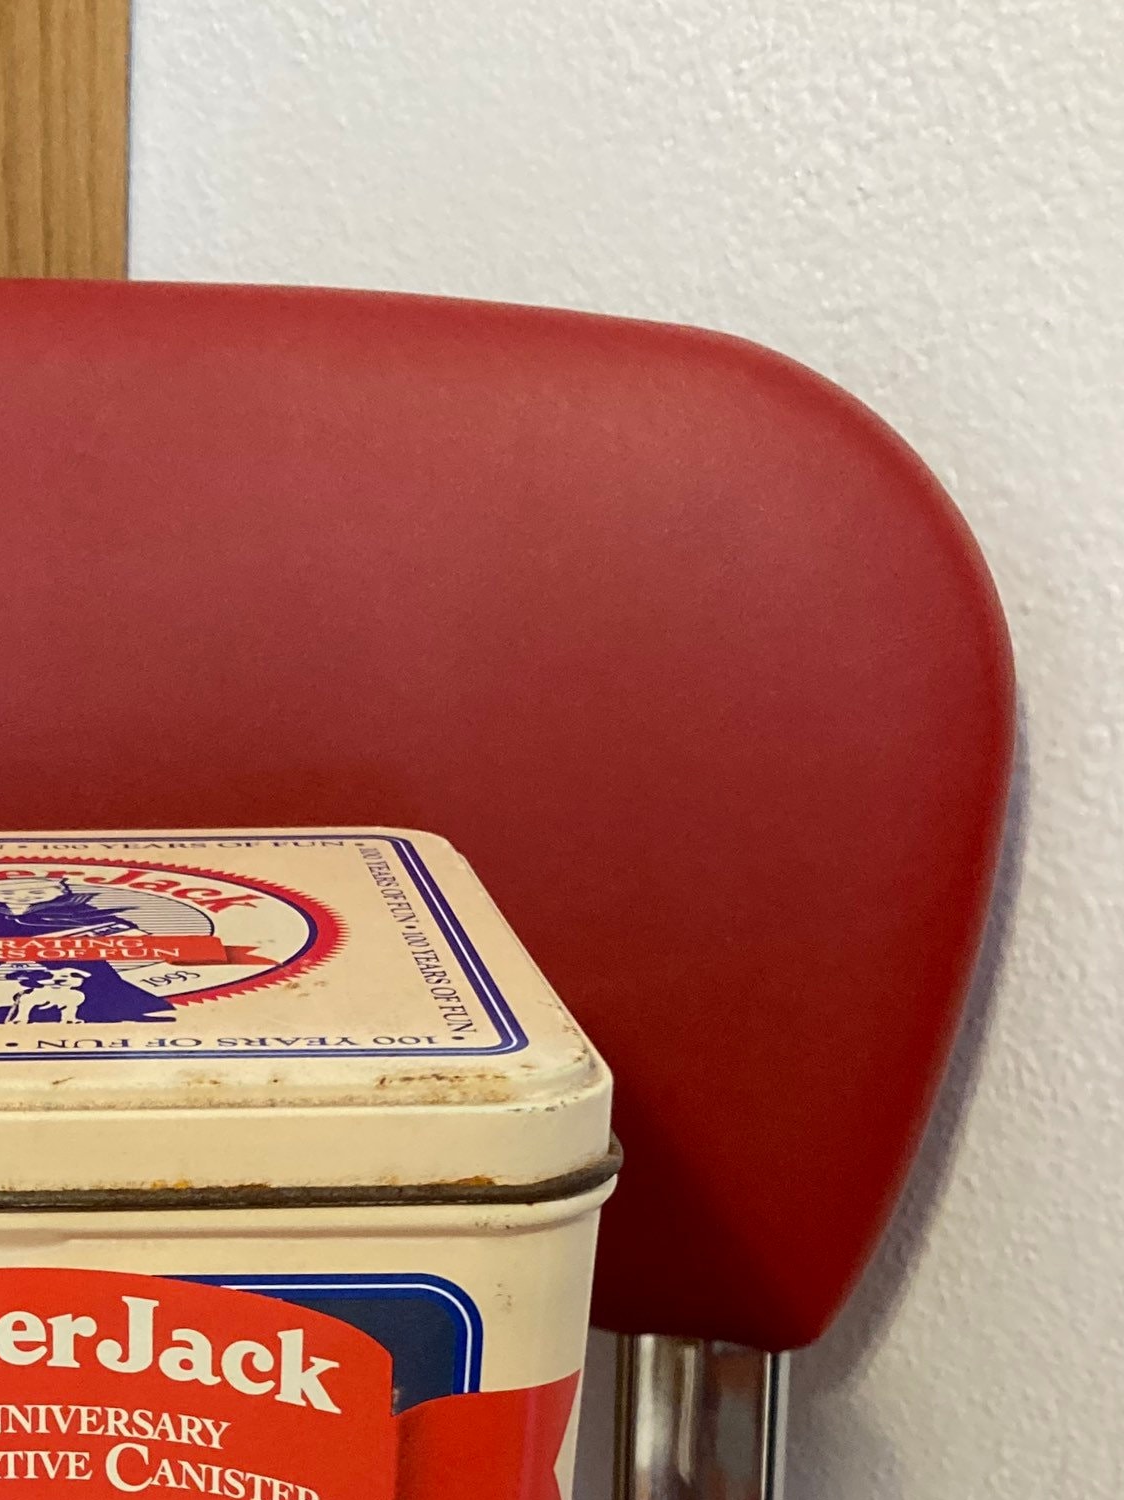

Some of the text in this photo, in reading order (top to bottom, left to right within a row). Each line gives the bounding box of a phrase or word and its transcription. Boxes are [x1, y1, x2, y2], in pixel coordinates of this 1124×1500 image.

[359, 847, 420, 923] 100 YEARS OF FUN
[37, 949, 88, 959] OF
[108, 948, 180, 958] FUN
[139, 970, 200, 988] 1993
[402, 932, 477, 1032] 100 YEARS OF FUN
[37, 1035, 438, 1049] 100 YEARS OF FUN
